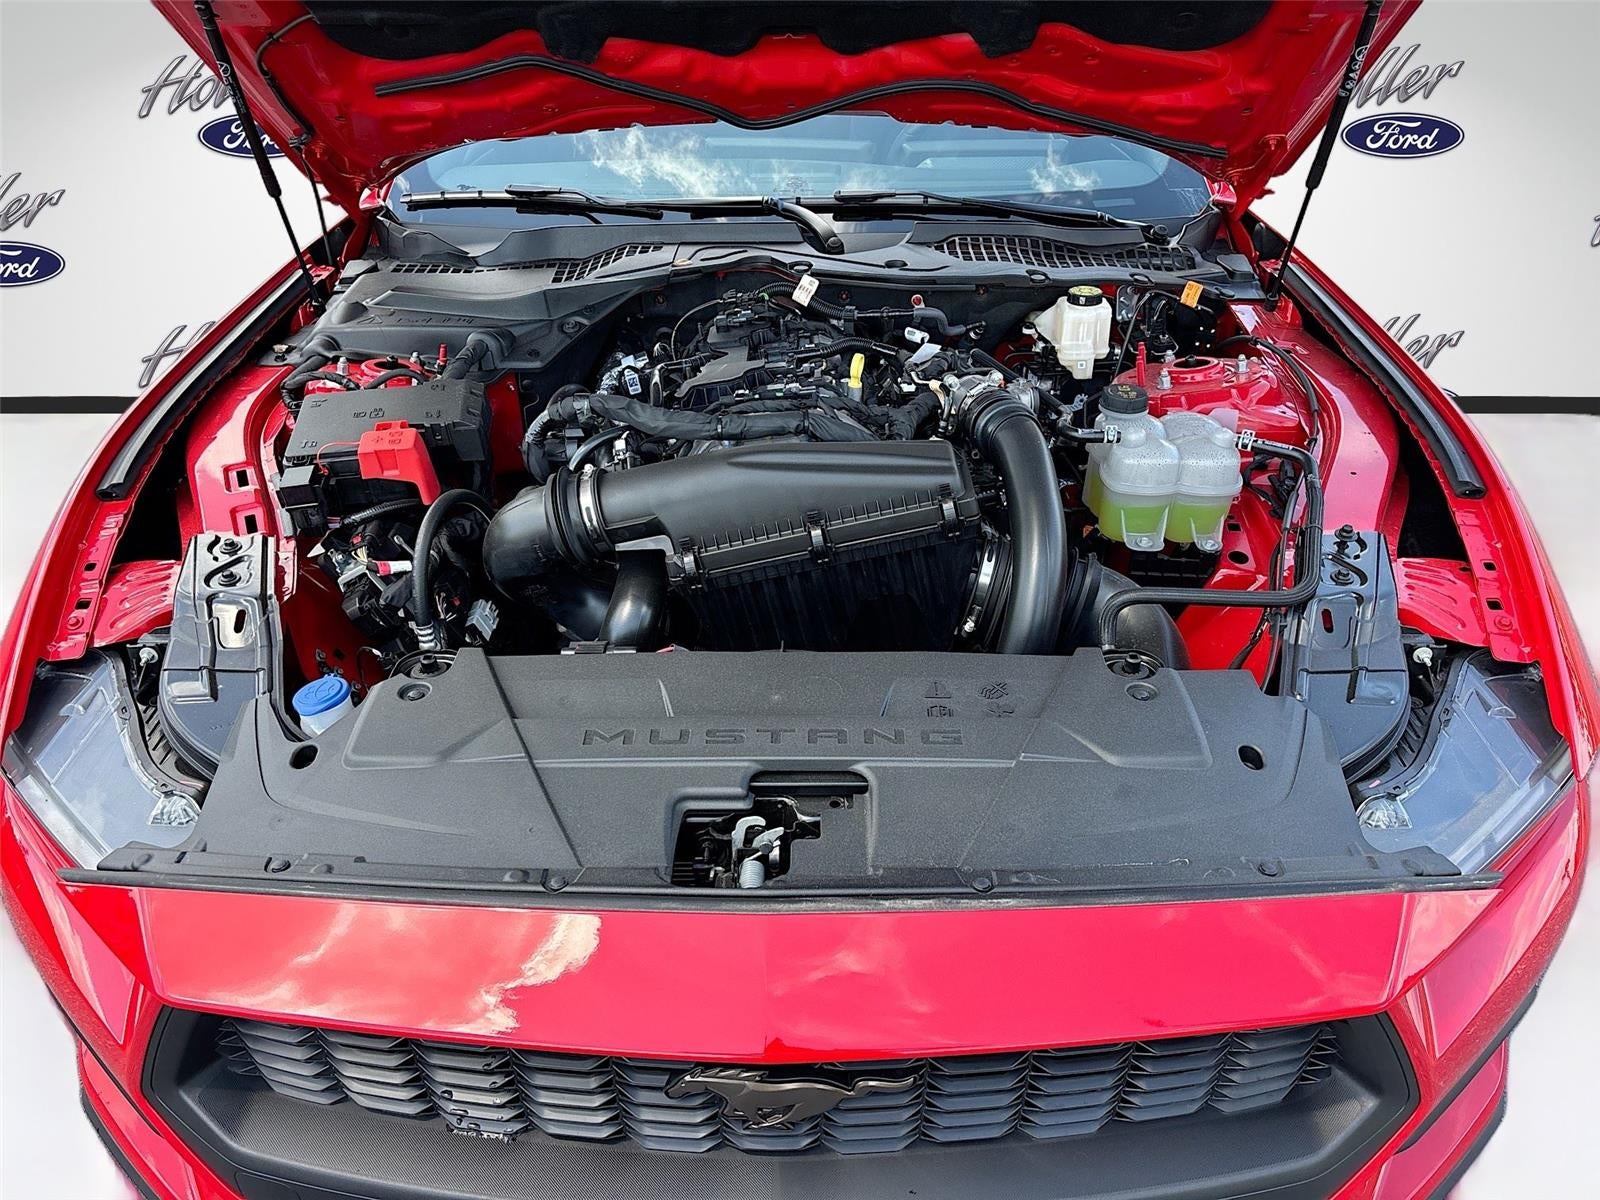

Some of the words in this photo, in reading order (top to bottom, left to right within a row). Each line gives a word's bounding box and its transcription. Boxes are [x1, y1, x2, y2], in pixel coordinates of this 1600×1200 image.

[1349, 43, 1465, 108] ller
[1365, 119, 1441, 149] Ford
[581, 728, 964, 746] MUSTANG
